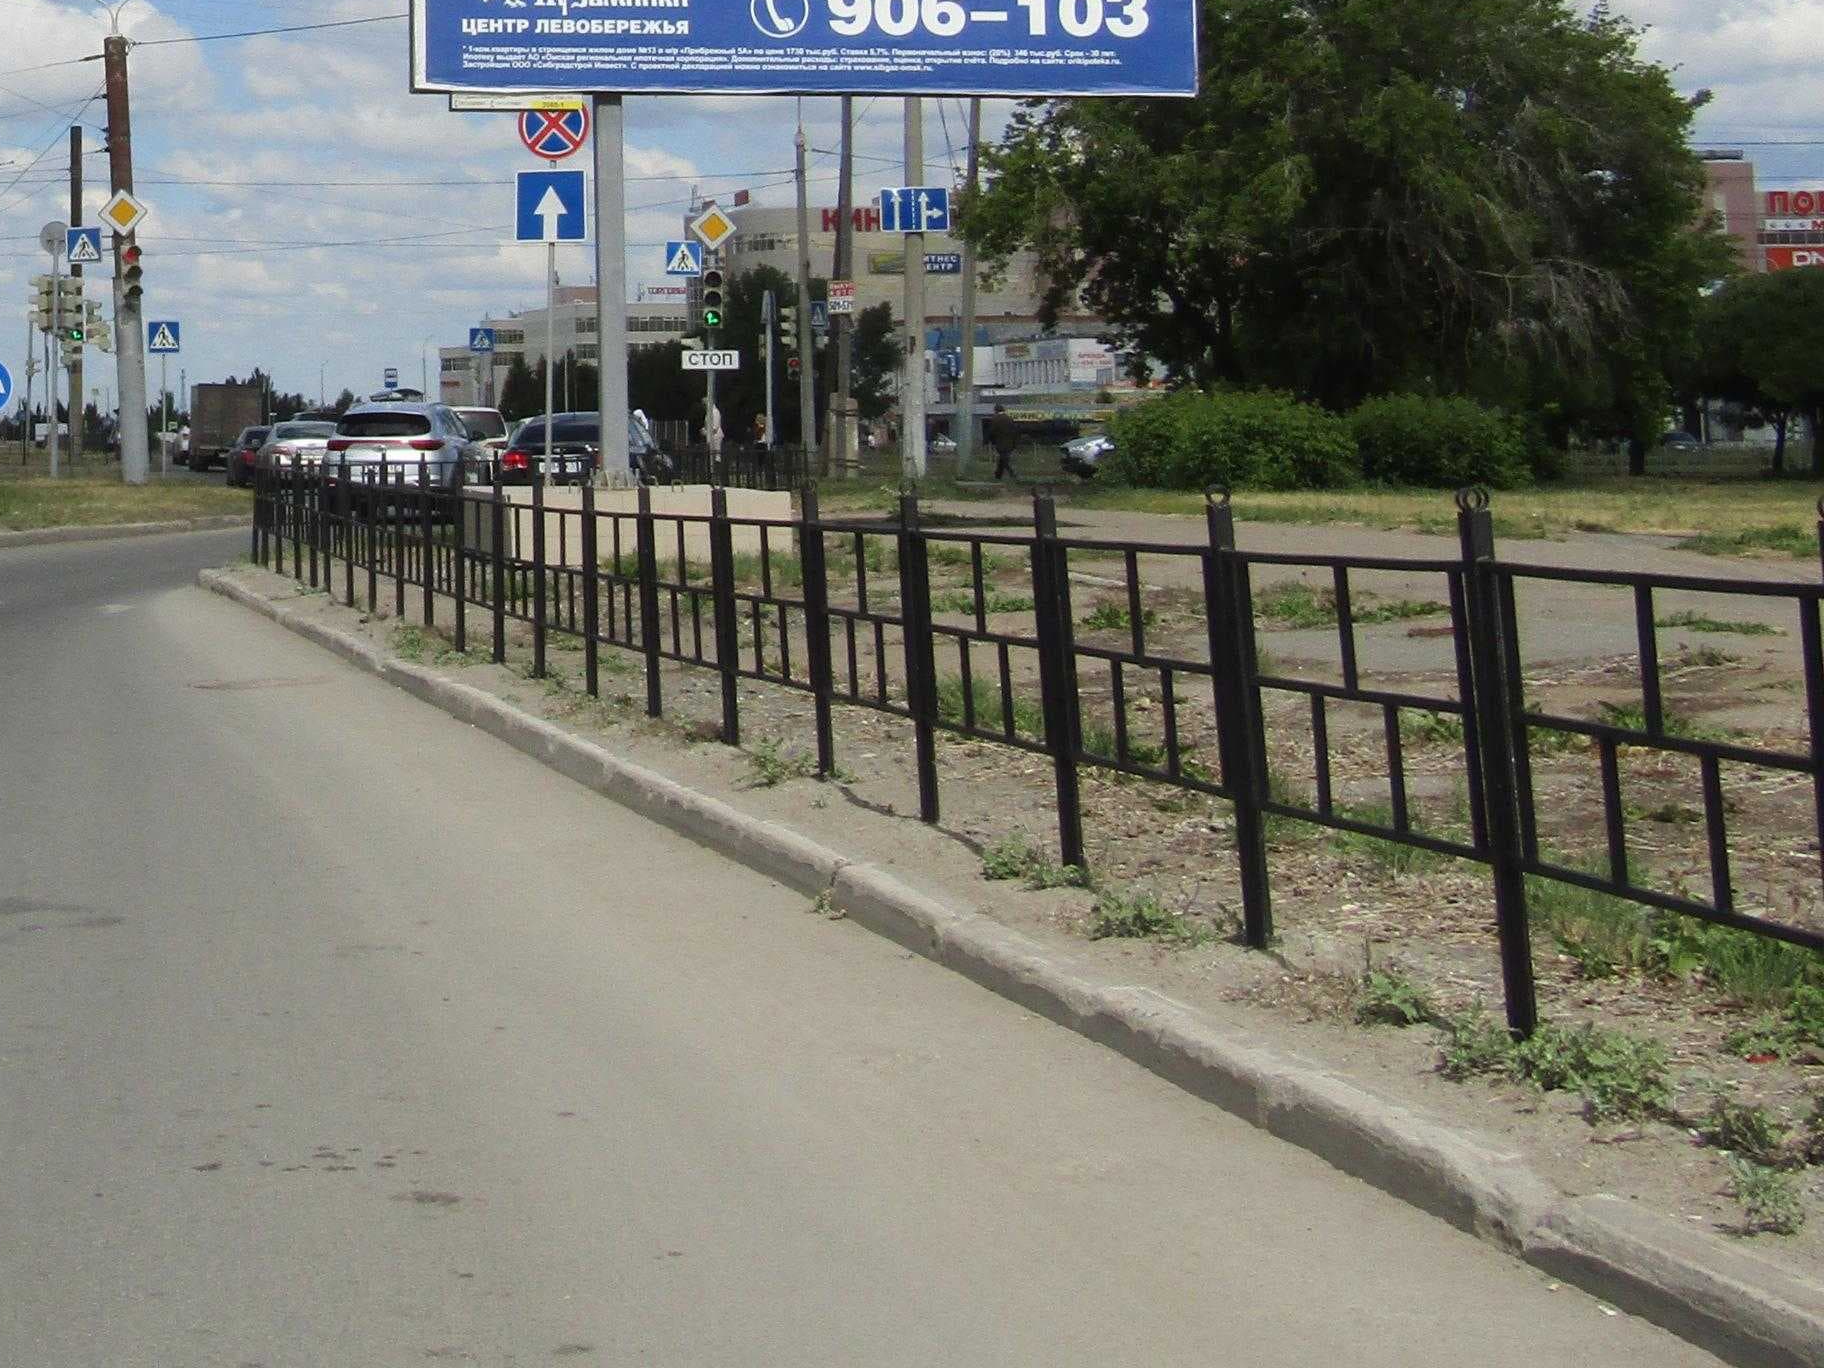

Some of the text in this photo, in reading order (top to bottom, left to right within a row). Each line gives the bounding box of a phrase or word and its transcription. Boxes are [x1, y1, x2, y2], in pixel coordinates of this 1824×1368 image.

[462, 18, 689, 36] ЦЕНТР ЛЕВОБЕРЕЖЬЯ
[688, 353, 732, 366] СТОП
